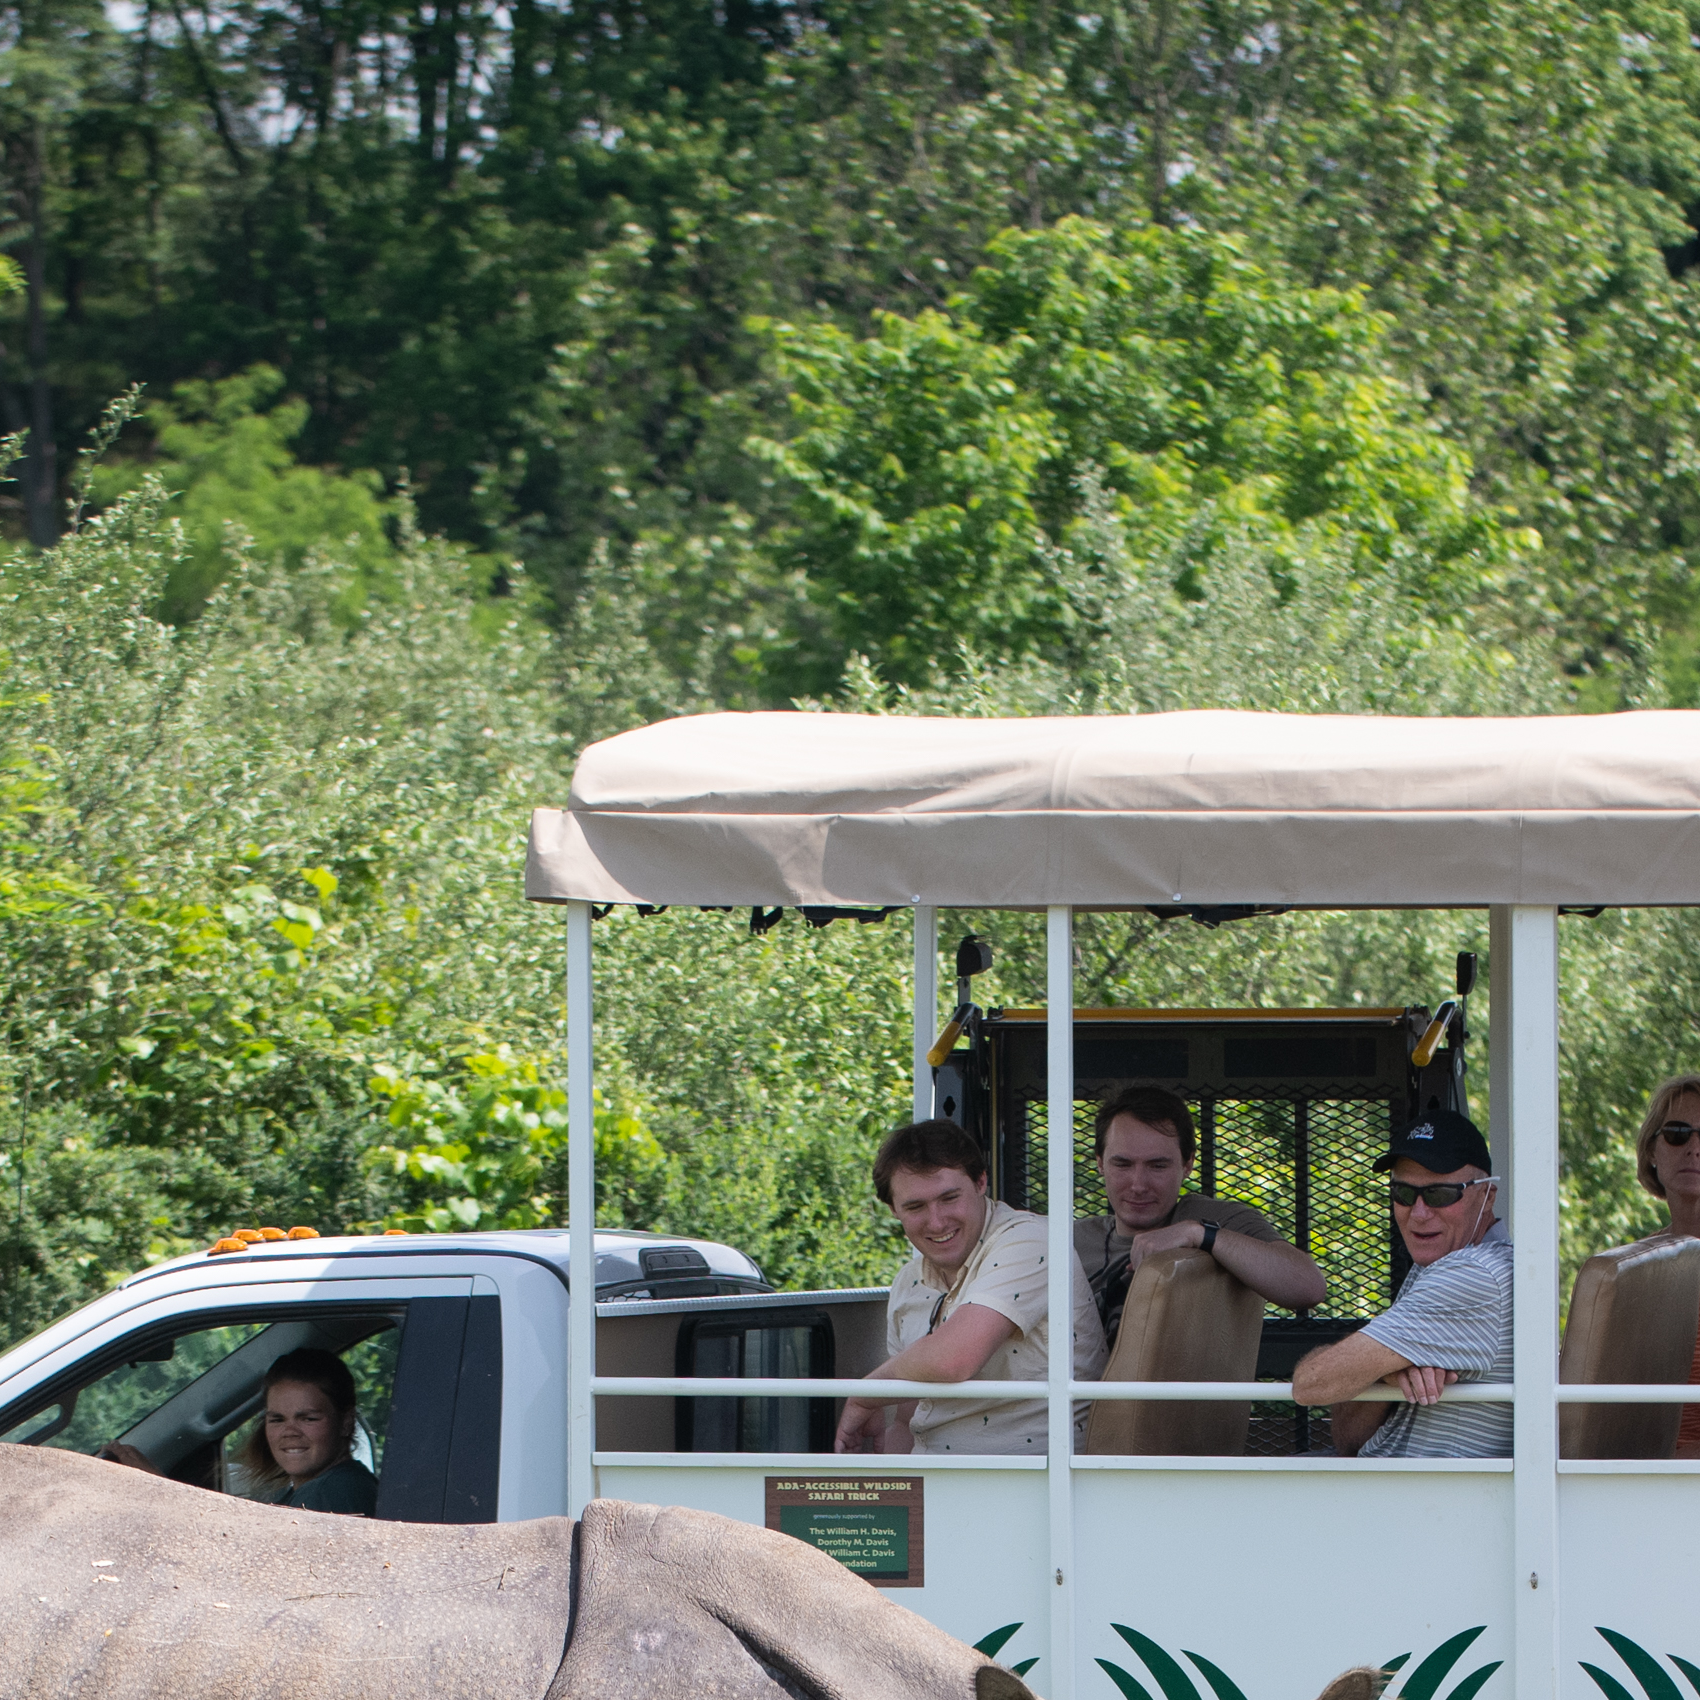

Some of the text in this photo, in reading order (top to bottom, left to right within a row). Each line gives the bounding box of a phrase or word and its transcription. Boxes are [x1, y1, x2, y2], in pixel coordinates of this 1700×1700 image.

[776, 1482, 912, 1491] ADA-ACCESSIBLE WILDSIDE
[808, 1492, 880, 1501] SAFARI TRUCK
[809, 1527, 897, 1537] The William H. Davis,
[817, 1538, 889, 1547] Dorothy M. Davis
[828, 1549, 861, 1557] William
[862, 1549, 871, 1557] C.
[872, 1549, 896, 1557] Davis
